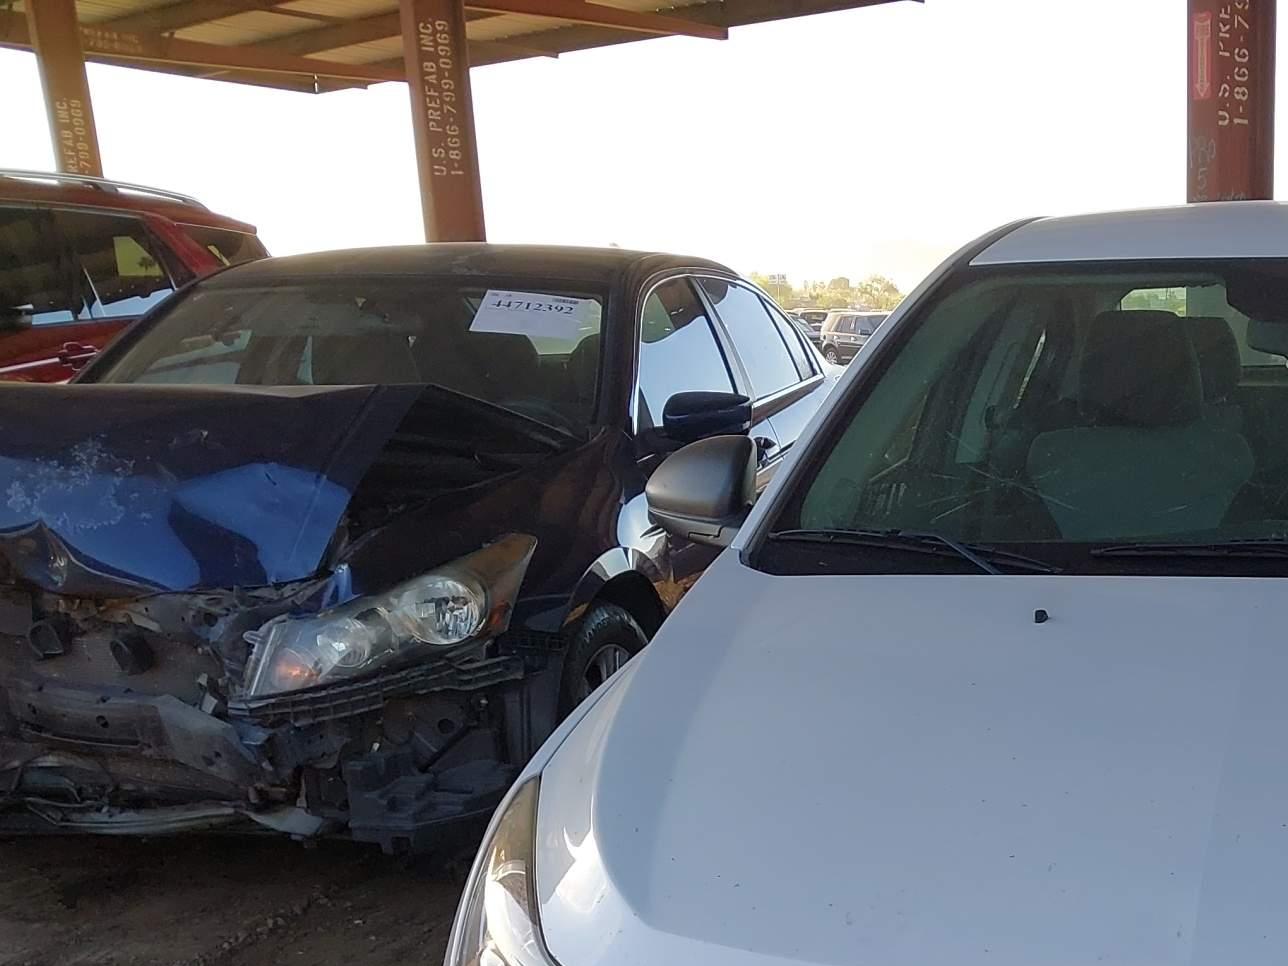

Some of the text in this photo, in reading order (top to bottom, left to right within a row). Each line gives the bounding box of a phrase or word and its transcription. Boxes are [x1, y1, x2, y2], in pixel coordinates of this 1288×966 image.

[419, 17, 435, 52] INC.
[423, 61, 443, 132] PREFAB
[435, 20, 464, 175] 1-866-799-0969
[491, 299, 575, 315] 44712392
